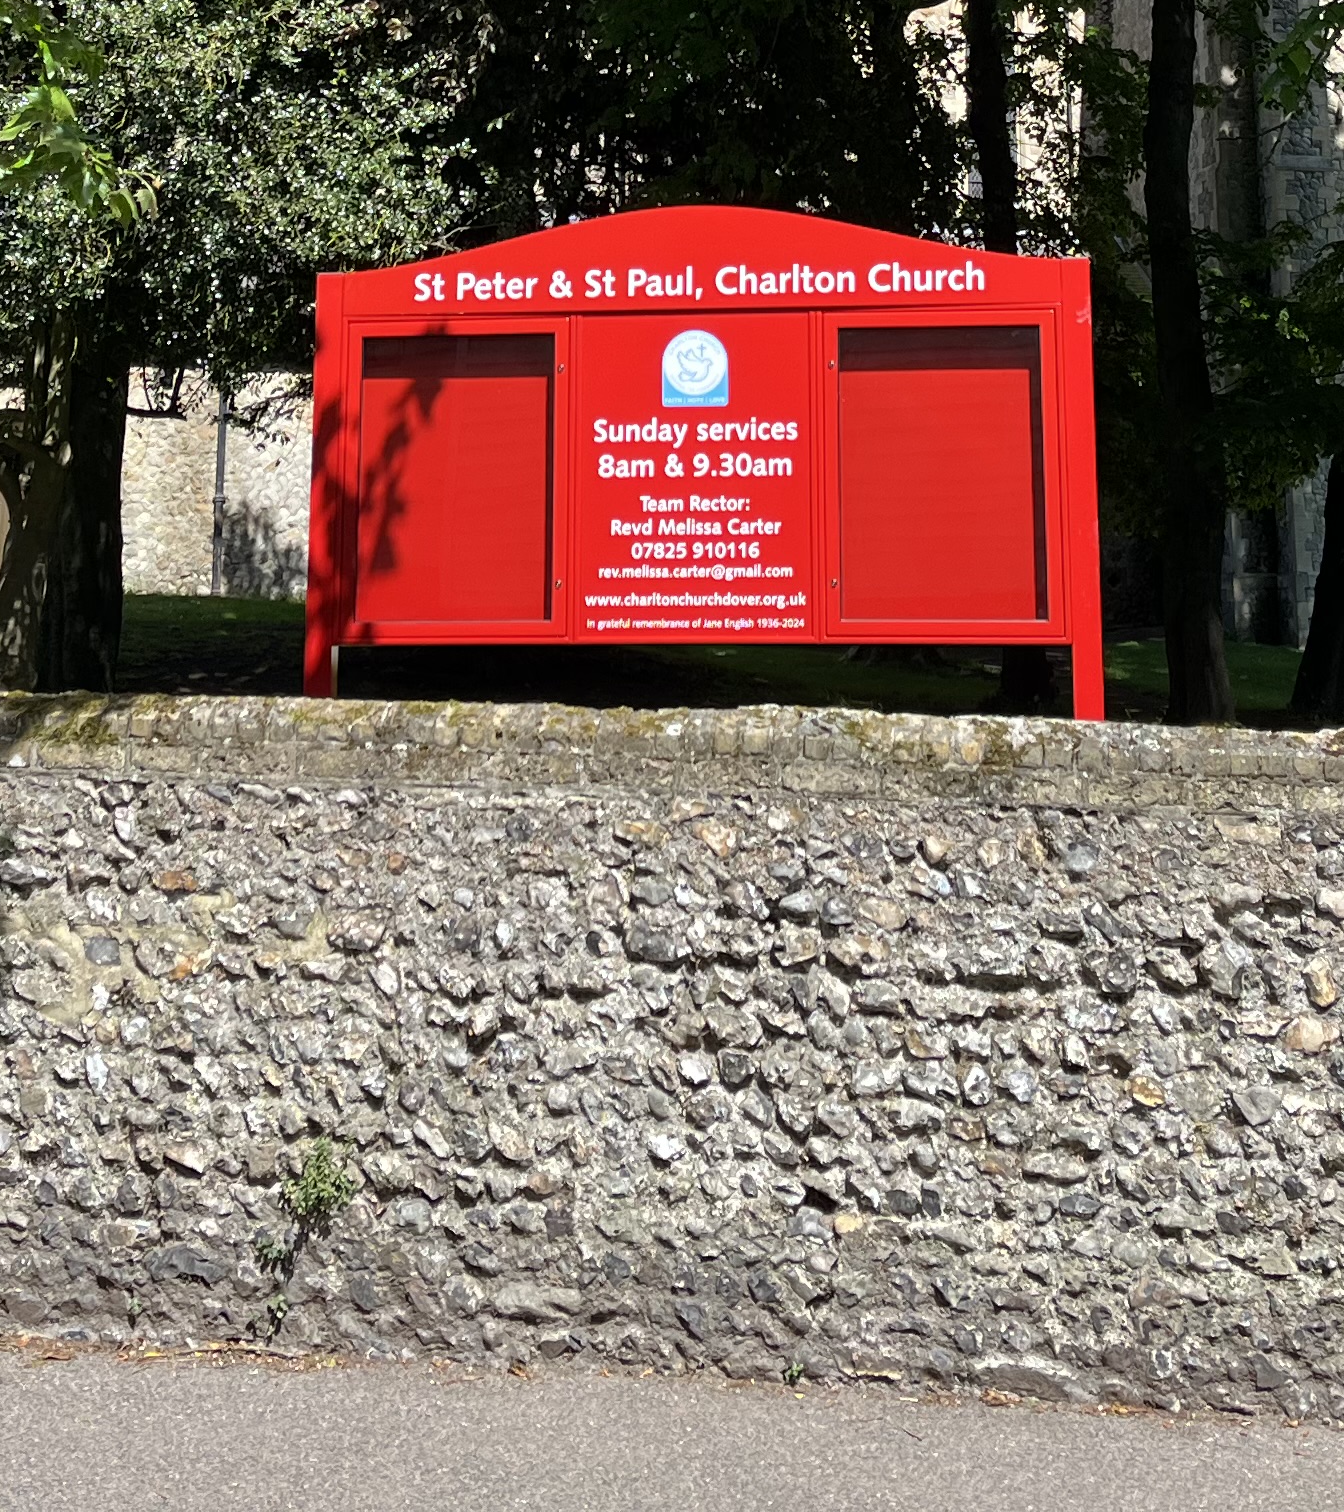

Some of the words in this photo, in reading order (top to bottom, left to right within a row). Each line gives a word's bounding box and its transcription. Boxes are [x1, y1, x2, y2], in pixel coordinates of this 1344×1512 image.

[414, 273, 445, 301] St
[457, 272, 538, 300] Peter
[549, 270, 573, 298] &
[585, 269, 615, 298] St
[628, 266, 703, 300] Paul,
[715, 264, 855, 295] Charlton
[868, 261, 984, 292] Church
[594, 417, 688, 448] Sunday
[697, 417, 798, 441] services
[598, 454, 654, 478] 8am
[665, 454, 684, 477] &
[693, 453, 792, 477] 9.30am
[640, 496, 684, 512] Team
[690, 495, 750, 511] Rector:
[611, 518, 652, 535] Revd
[658, 518, 722, 535] Melissa
[728, 518, 781, 535] Carter
[631, 542, 687, 559] 07825
[692, 542, 760, 559] 910116
[599, 564, 793, 581] rev.melissa.carter@gmail.com
[585, 592, 806, 609] www.charltonchurchdover.org.uk
[587, 619, 595, 628] In
[598, 618, 630, 630] grateful
[632, 618, 690, 628] remembrance
[692, 618, 701, 628] of
[703, 619, 722, 628] Jane
[725, 618, 754, 630] English
